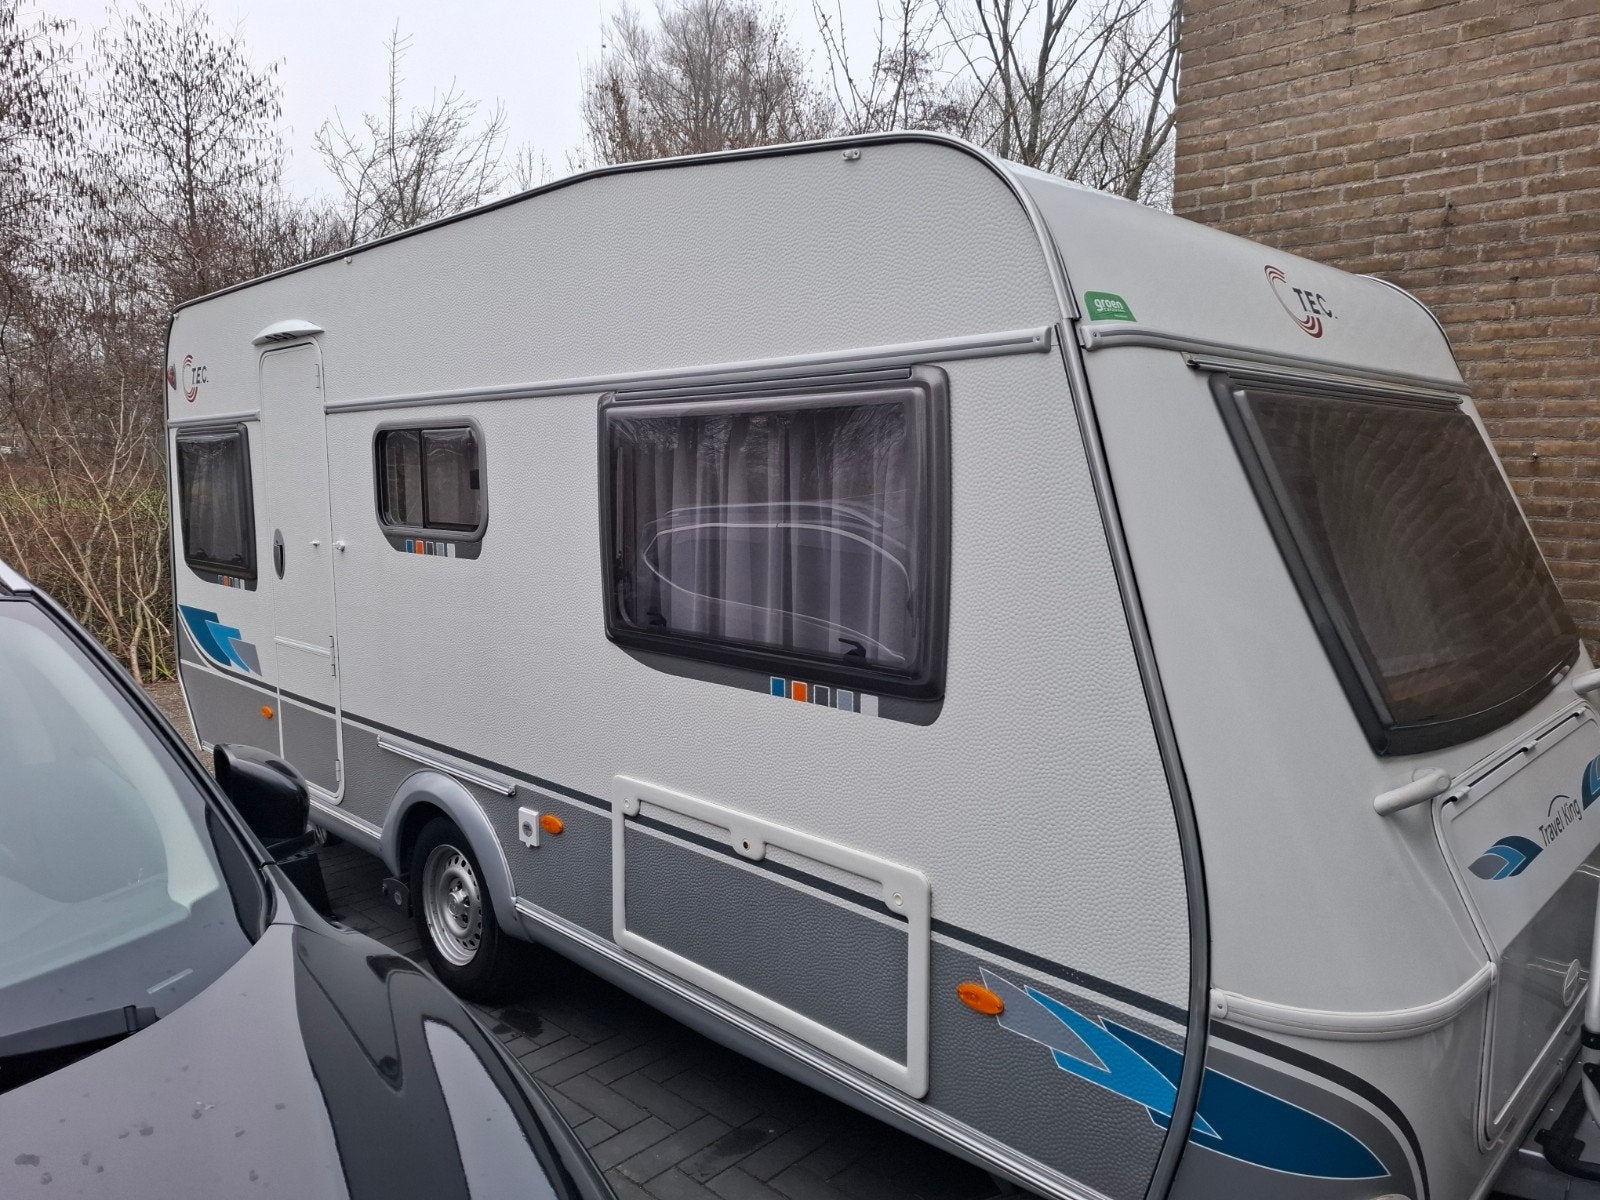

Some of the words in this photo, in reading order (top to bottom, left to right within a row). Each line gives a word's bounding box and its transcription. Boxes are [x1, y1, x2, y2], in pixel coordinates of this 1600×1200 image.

[1094, 298, 1124, 312] groen
[1538, 810, 1565, 847] Travel
[1561, 799, 1583, 826] King
